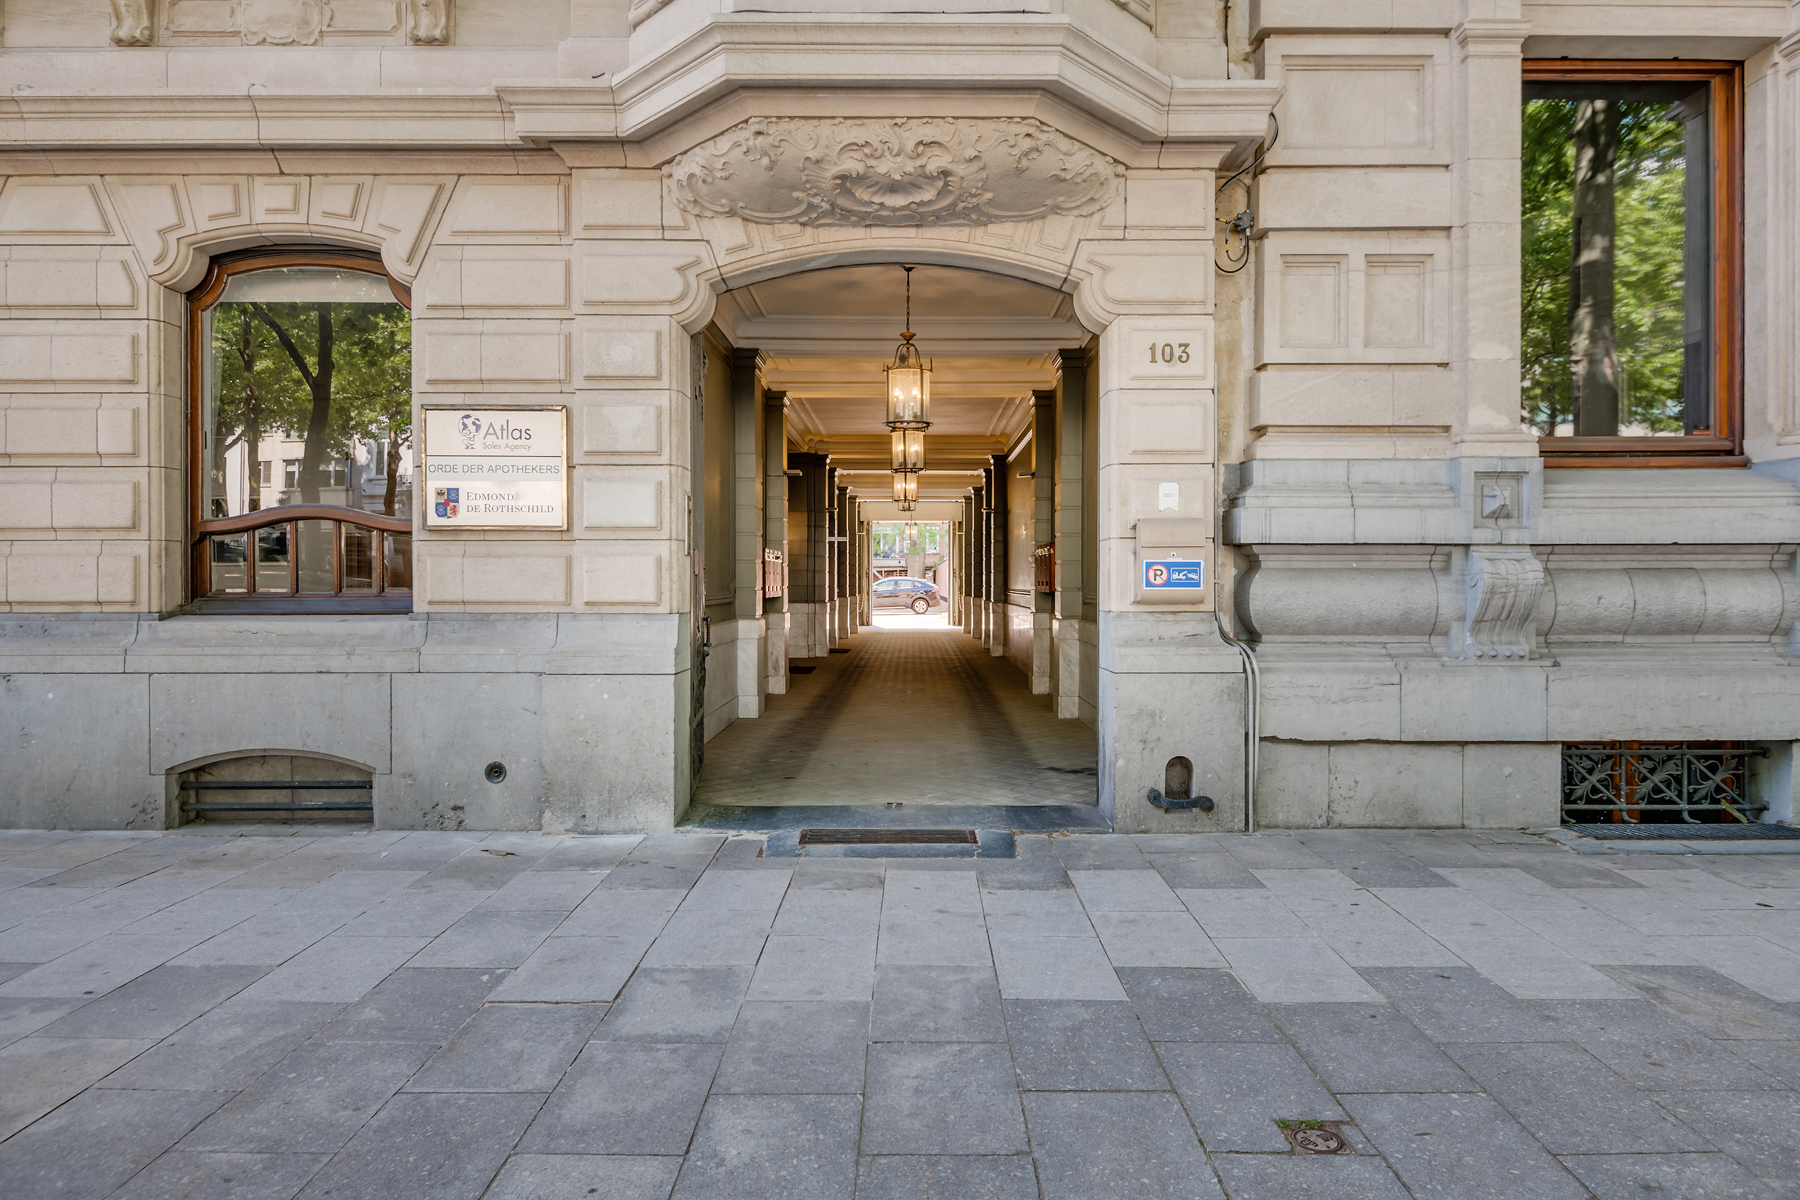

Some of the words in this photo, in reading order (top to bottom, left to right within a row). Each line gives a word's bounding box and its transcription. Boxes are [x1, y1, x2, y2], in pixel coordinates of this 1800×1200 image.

[1149, 342, 1190, 363] 103
[483, 419, 532, 441] Atlas
[483, 442, 501, 450] Sales
[504, 442, 532, 452] Agency
[428, 464, 459, 474] ORDE
[462, 464, 484, 474] DER
[487, 464, 560, 474] APOTHEKERS
[466, 492, 514, 501] EDMOND
[466, 505, 481, 513] DE
[484, 503, 554, 513] ROTHSCHILD
